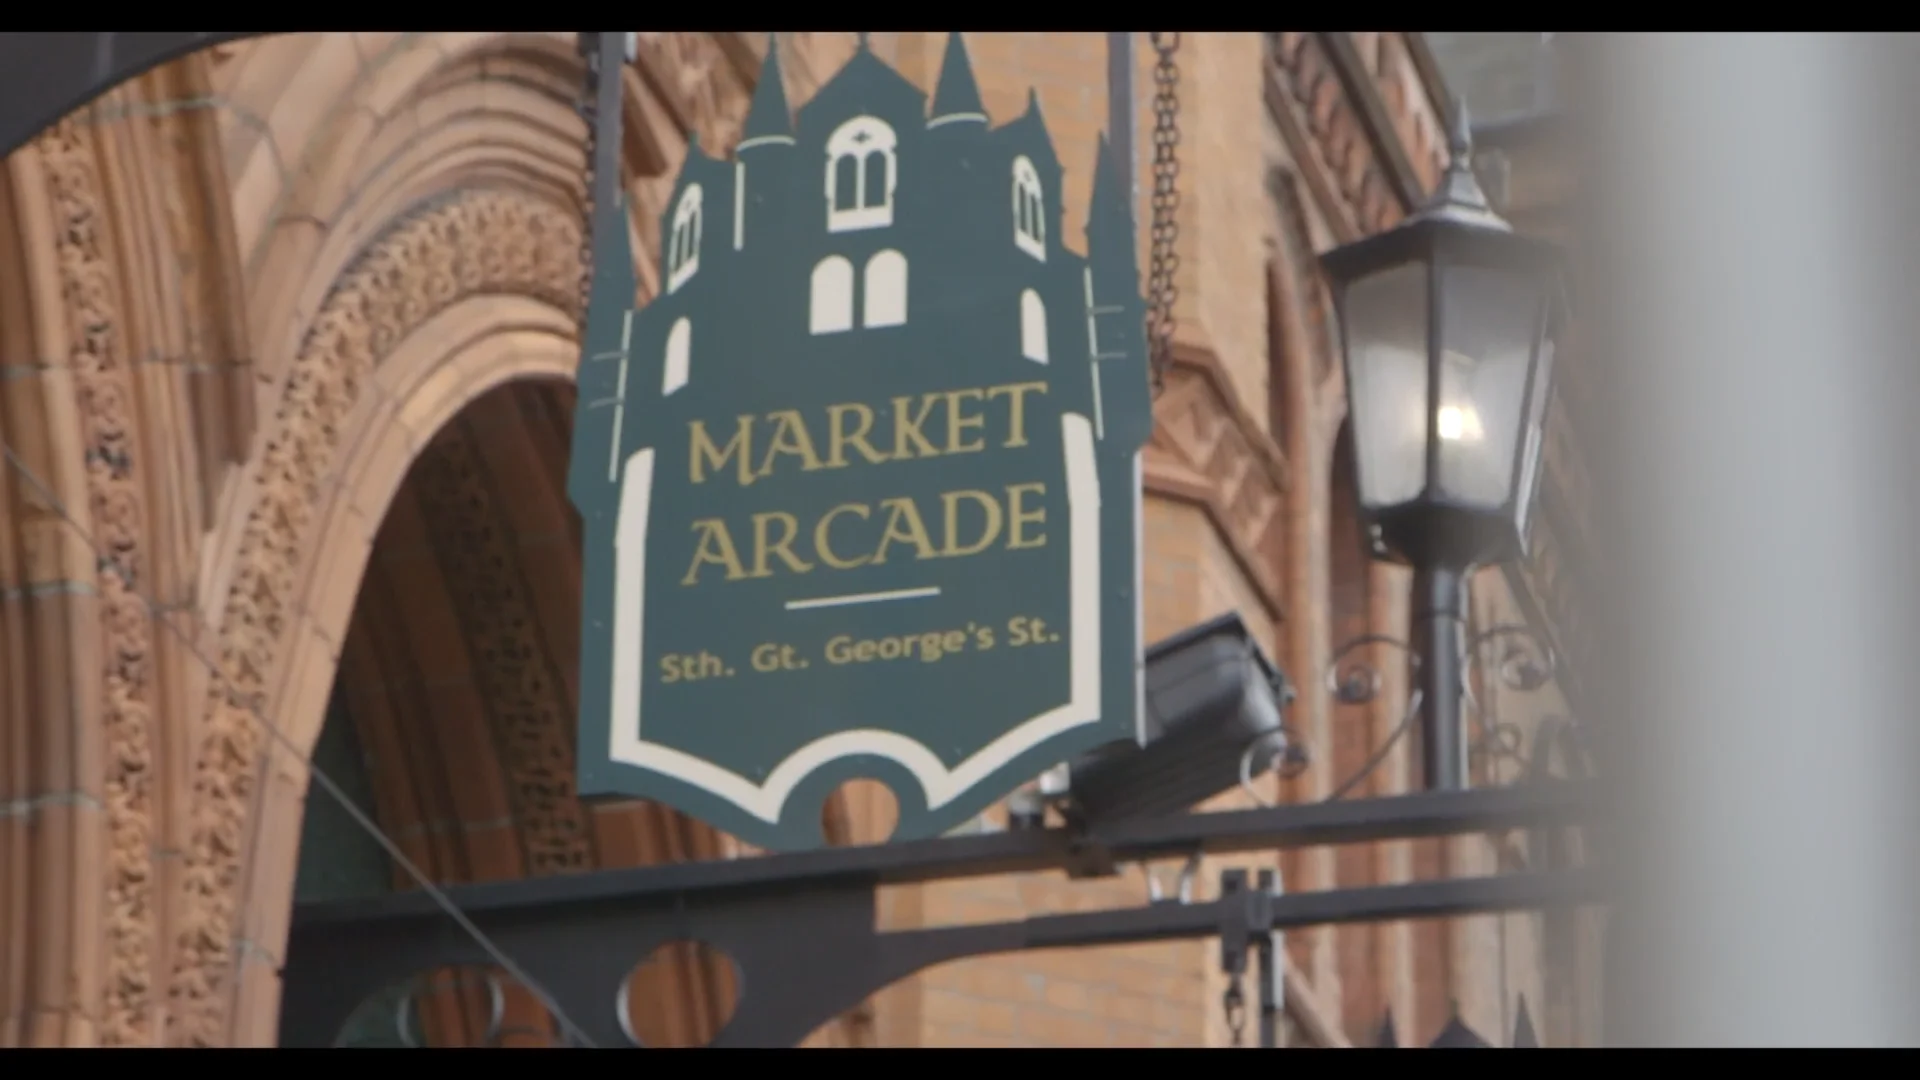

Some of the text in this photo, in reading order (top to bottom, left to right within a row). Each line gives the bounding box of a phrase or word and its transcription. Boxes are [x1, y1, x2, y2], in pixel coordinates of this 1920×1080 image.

[688, 381, 1048, 486] MARKET
[680, 482, 1047, 586] ARCADE
[660, 616, 1060, 682] Sth. Gt. George's St.
